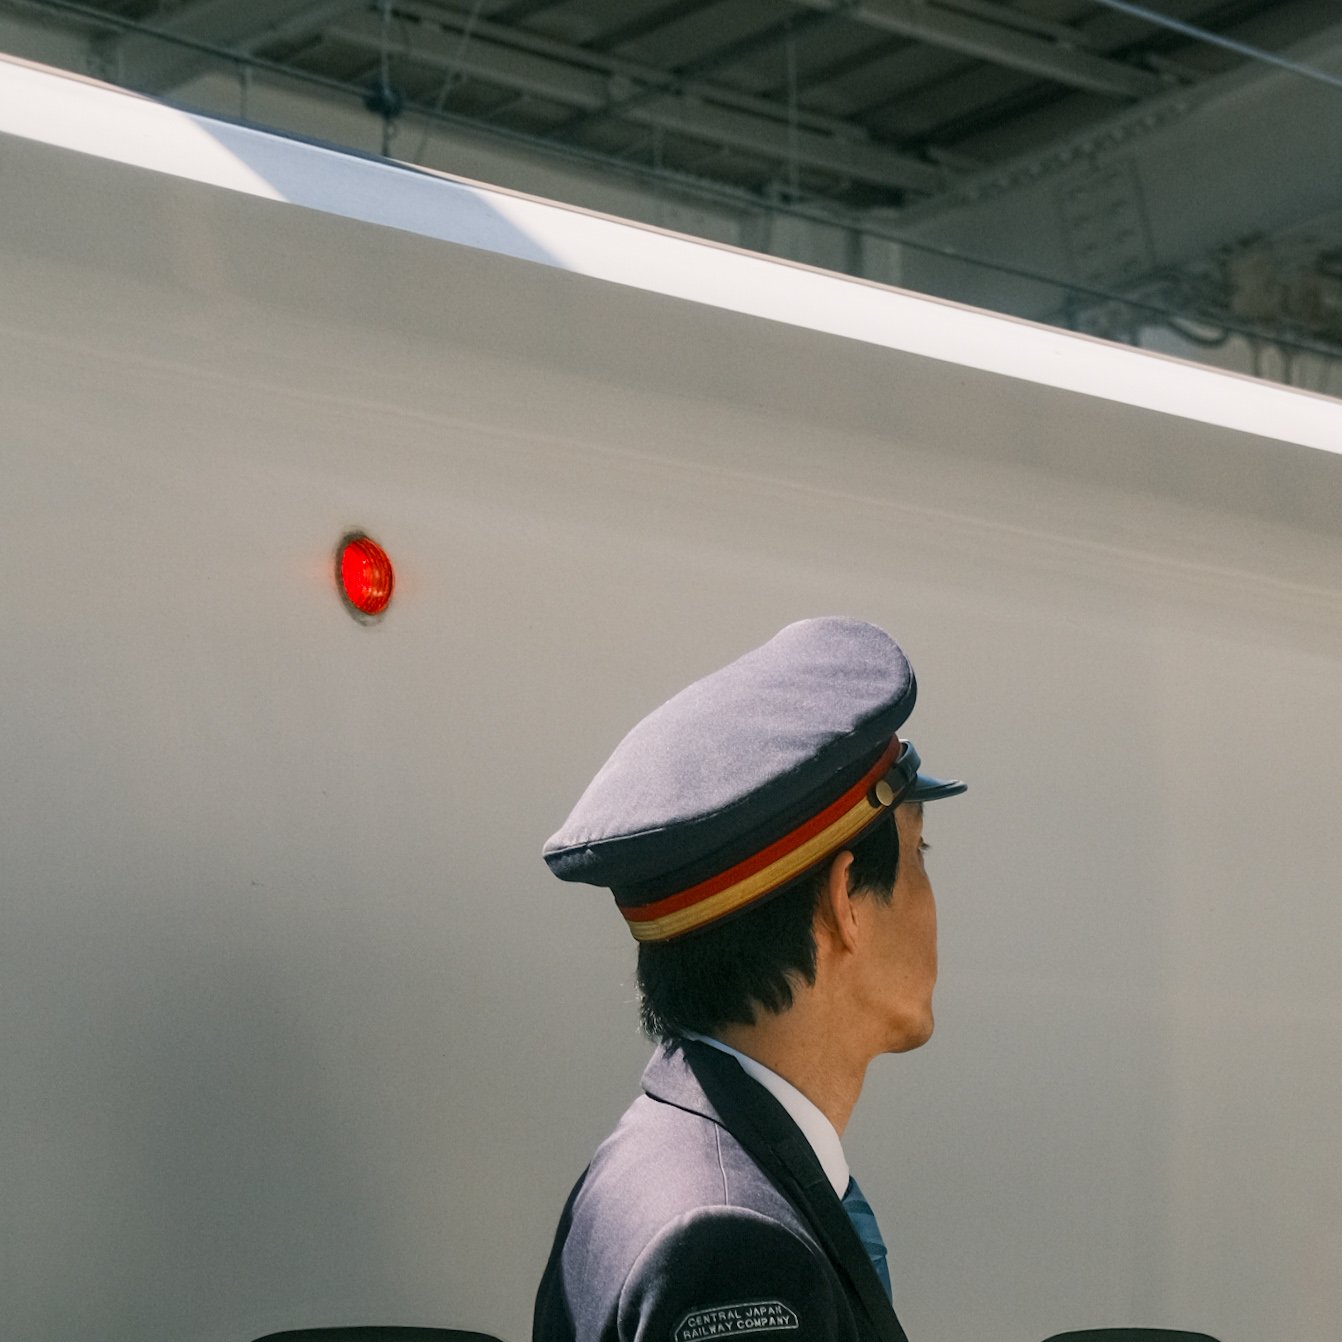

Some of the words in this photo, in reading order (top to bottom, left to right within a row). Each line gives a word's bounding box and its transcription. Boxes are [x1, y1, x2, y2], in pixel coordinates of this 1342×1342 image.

[684, 1321, 733, 1340] RAILWAY
[737, 1315, 790, 1329] COMPANY
[688, 1309, 741, 1328] CENTRAL
[746, 1305, 782, 1318] JAPAN
